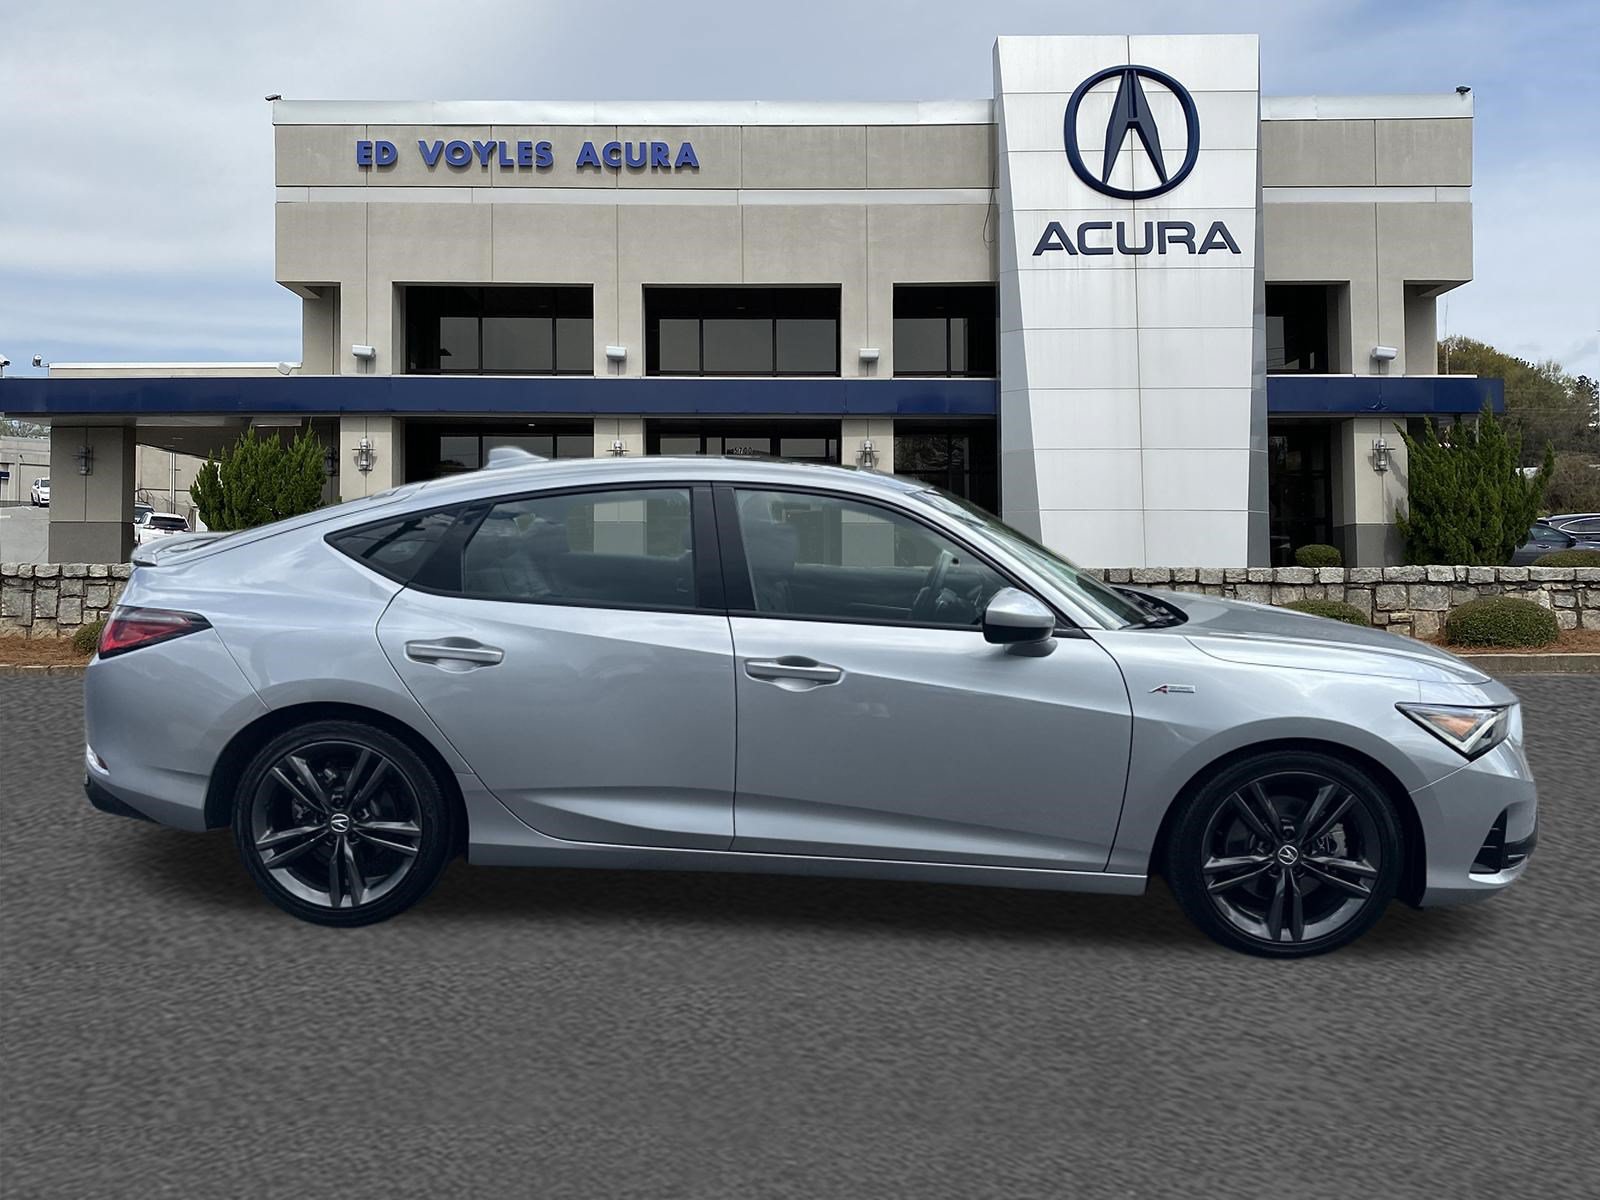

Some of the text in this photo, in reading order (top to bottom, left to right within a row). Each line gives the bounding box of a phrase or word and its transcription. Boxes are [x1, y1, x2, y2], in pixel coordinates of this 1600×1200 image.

[357, 140, 699, 167] ED VOYLES ACURA
[1032, 221, 1241, 256] ACURA
